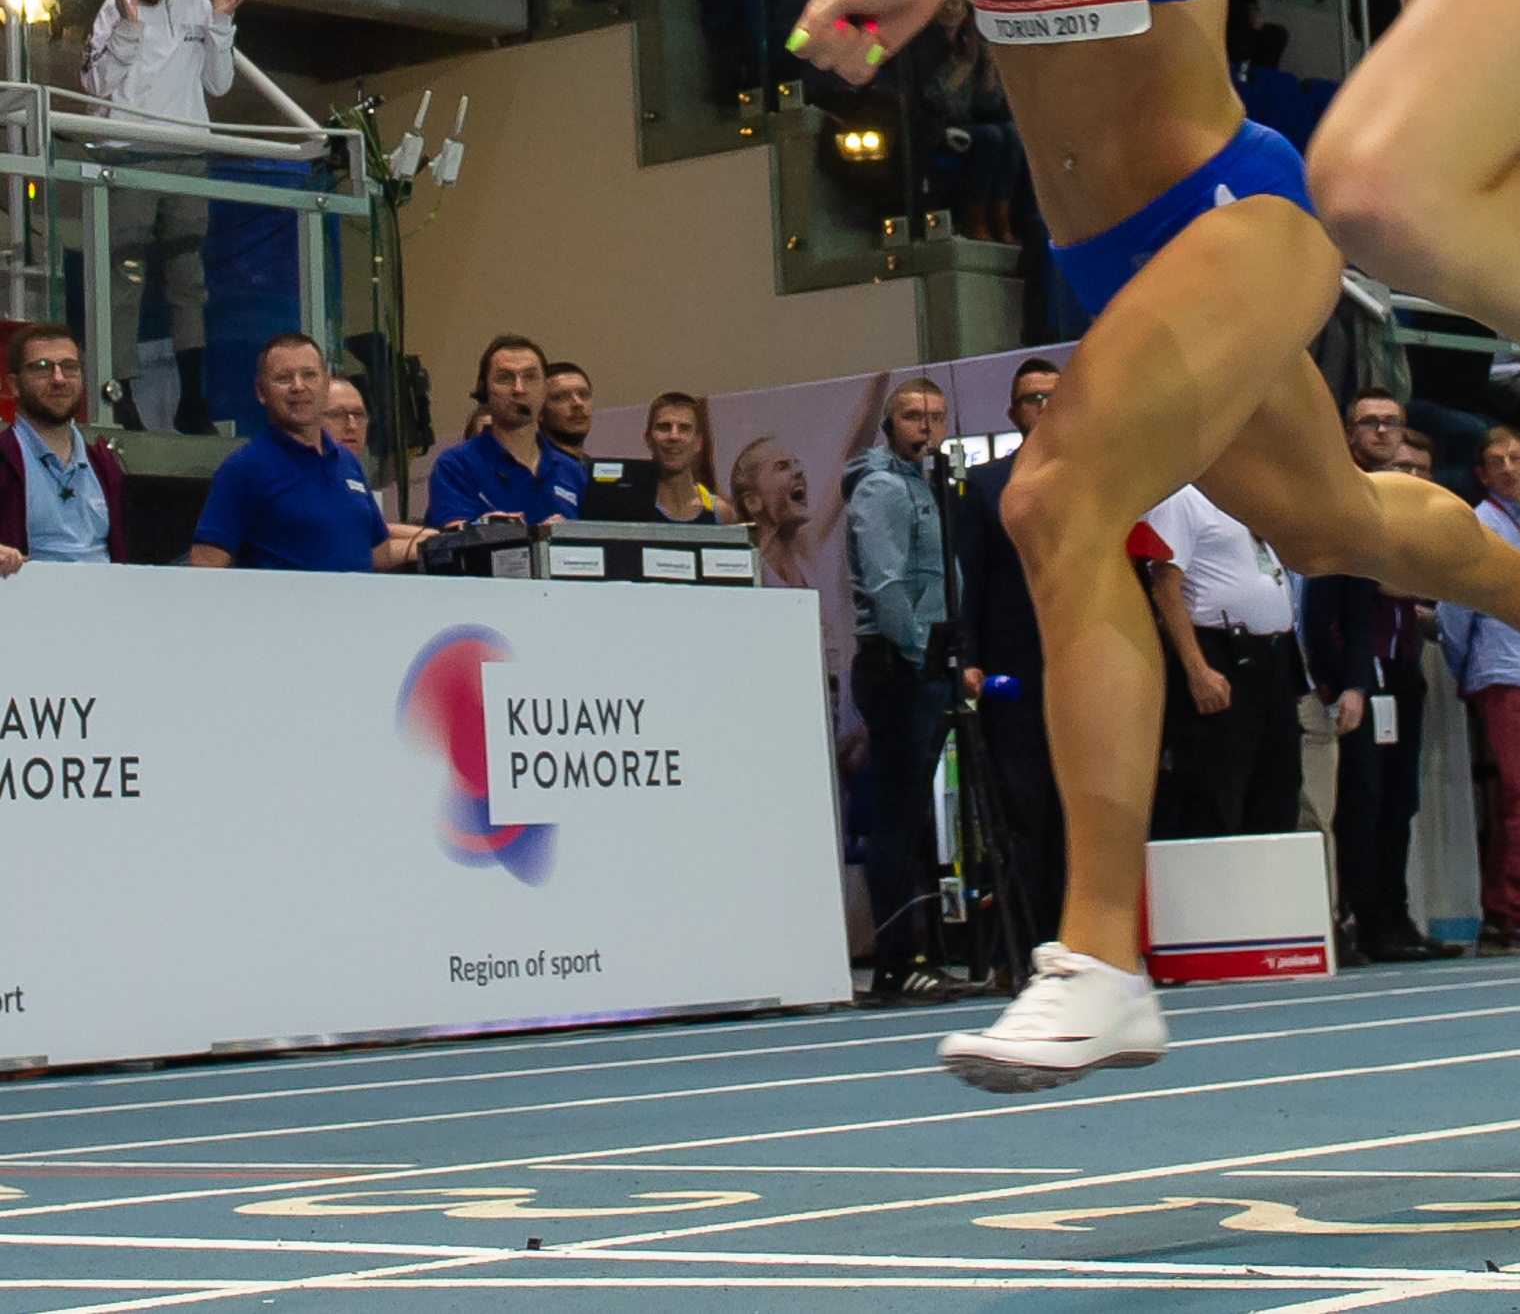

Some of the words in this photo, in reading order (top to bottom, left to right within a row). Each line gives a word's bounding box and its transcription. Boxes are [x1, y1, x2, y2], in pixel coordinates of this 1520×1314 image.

[1052, 13, 1100, 36] 2019
[507, 697, 645, 736] KUJAWY
[510, 750, 682, 790] POMORZE
[450, 953, 520, 987] Region
[525, 950, 545, 977] of
[551, 950, 602, 980] sport
